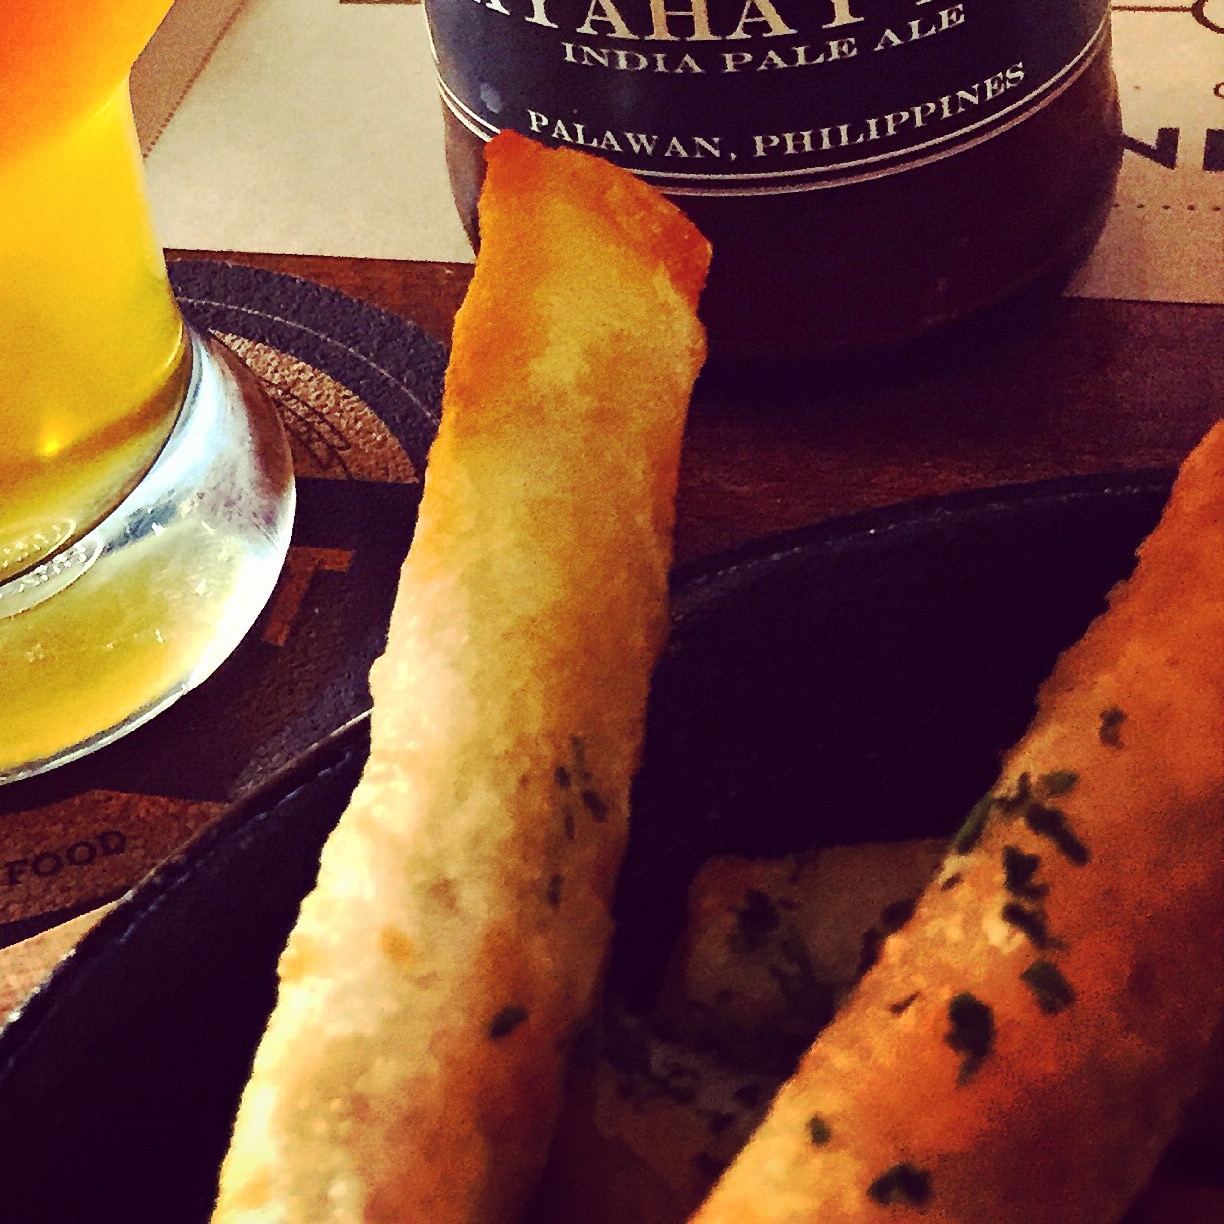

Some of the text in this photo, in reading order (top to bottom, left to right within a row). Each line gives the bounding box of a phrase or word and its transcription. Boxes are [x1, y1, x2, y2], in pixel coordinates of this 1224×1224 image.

[561, 4, 965, 73] INDIA PALE ALE
[527, 62, 1025, 161] PALAWAN, PHILIPPINES
[5, 830, 127, 886] FOOD
